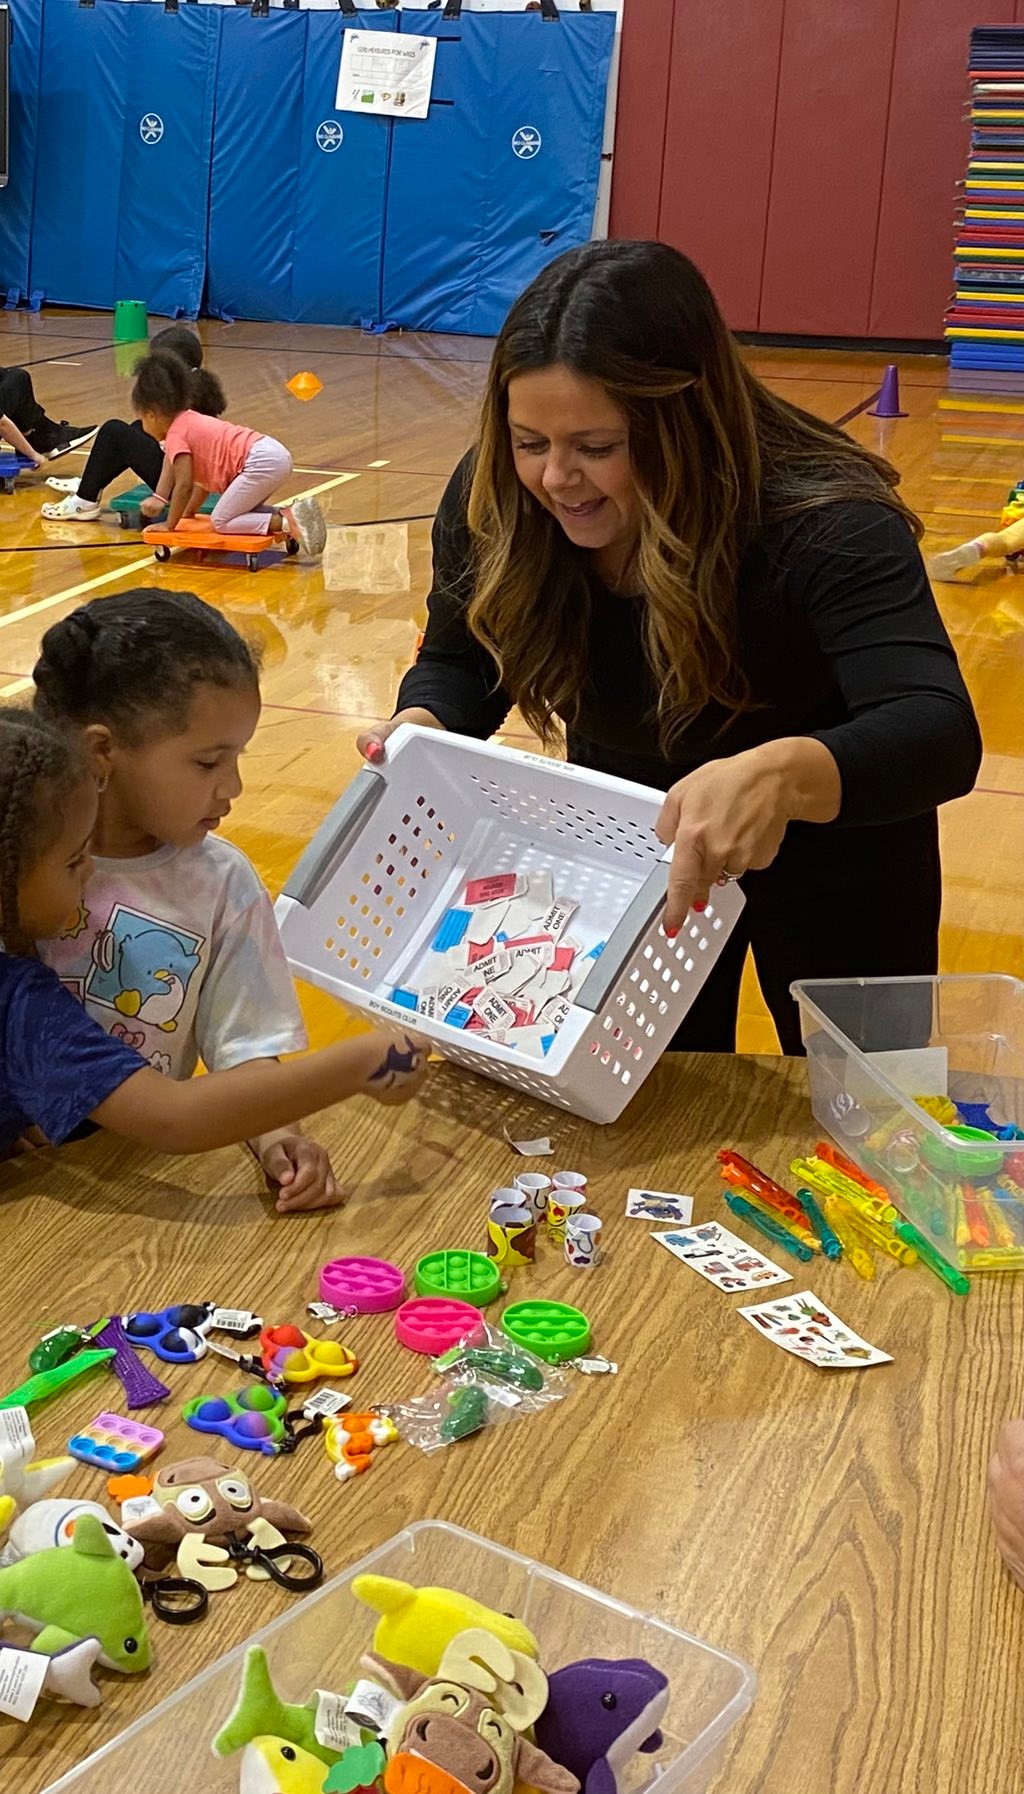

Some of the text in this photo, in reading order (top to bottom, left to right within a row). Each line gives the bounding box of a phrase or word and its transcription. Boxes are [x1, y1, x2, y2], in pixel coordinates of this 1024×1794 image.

[543, 905, 560, 931] ADMIT
[552, 912, 566, 930] ONE
[473, 955, 497, 973] ADMIT
[483, 966, 496, 977] NE
[438, 986, 453, 1003] ONE
[441, 987, 461, 1011] ADMIT
[368, 1000, 417, 1025] BOY SCOUTS CLUB
[483, 1007, 498, 1023] ONE
[488, 997, 508, 1018] ADMIT
